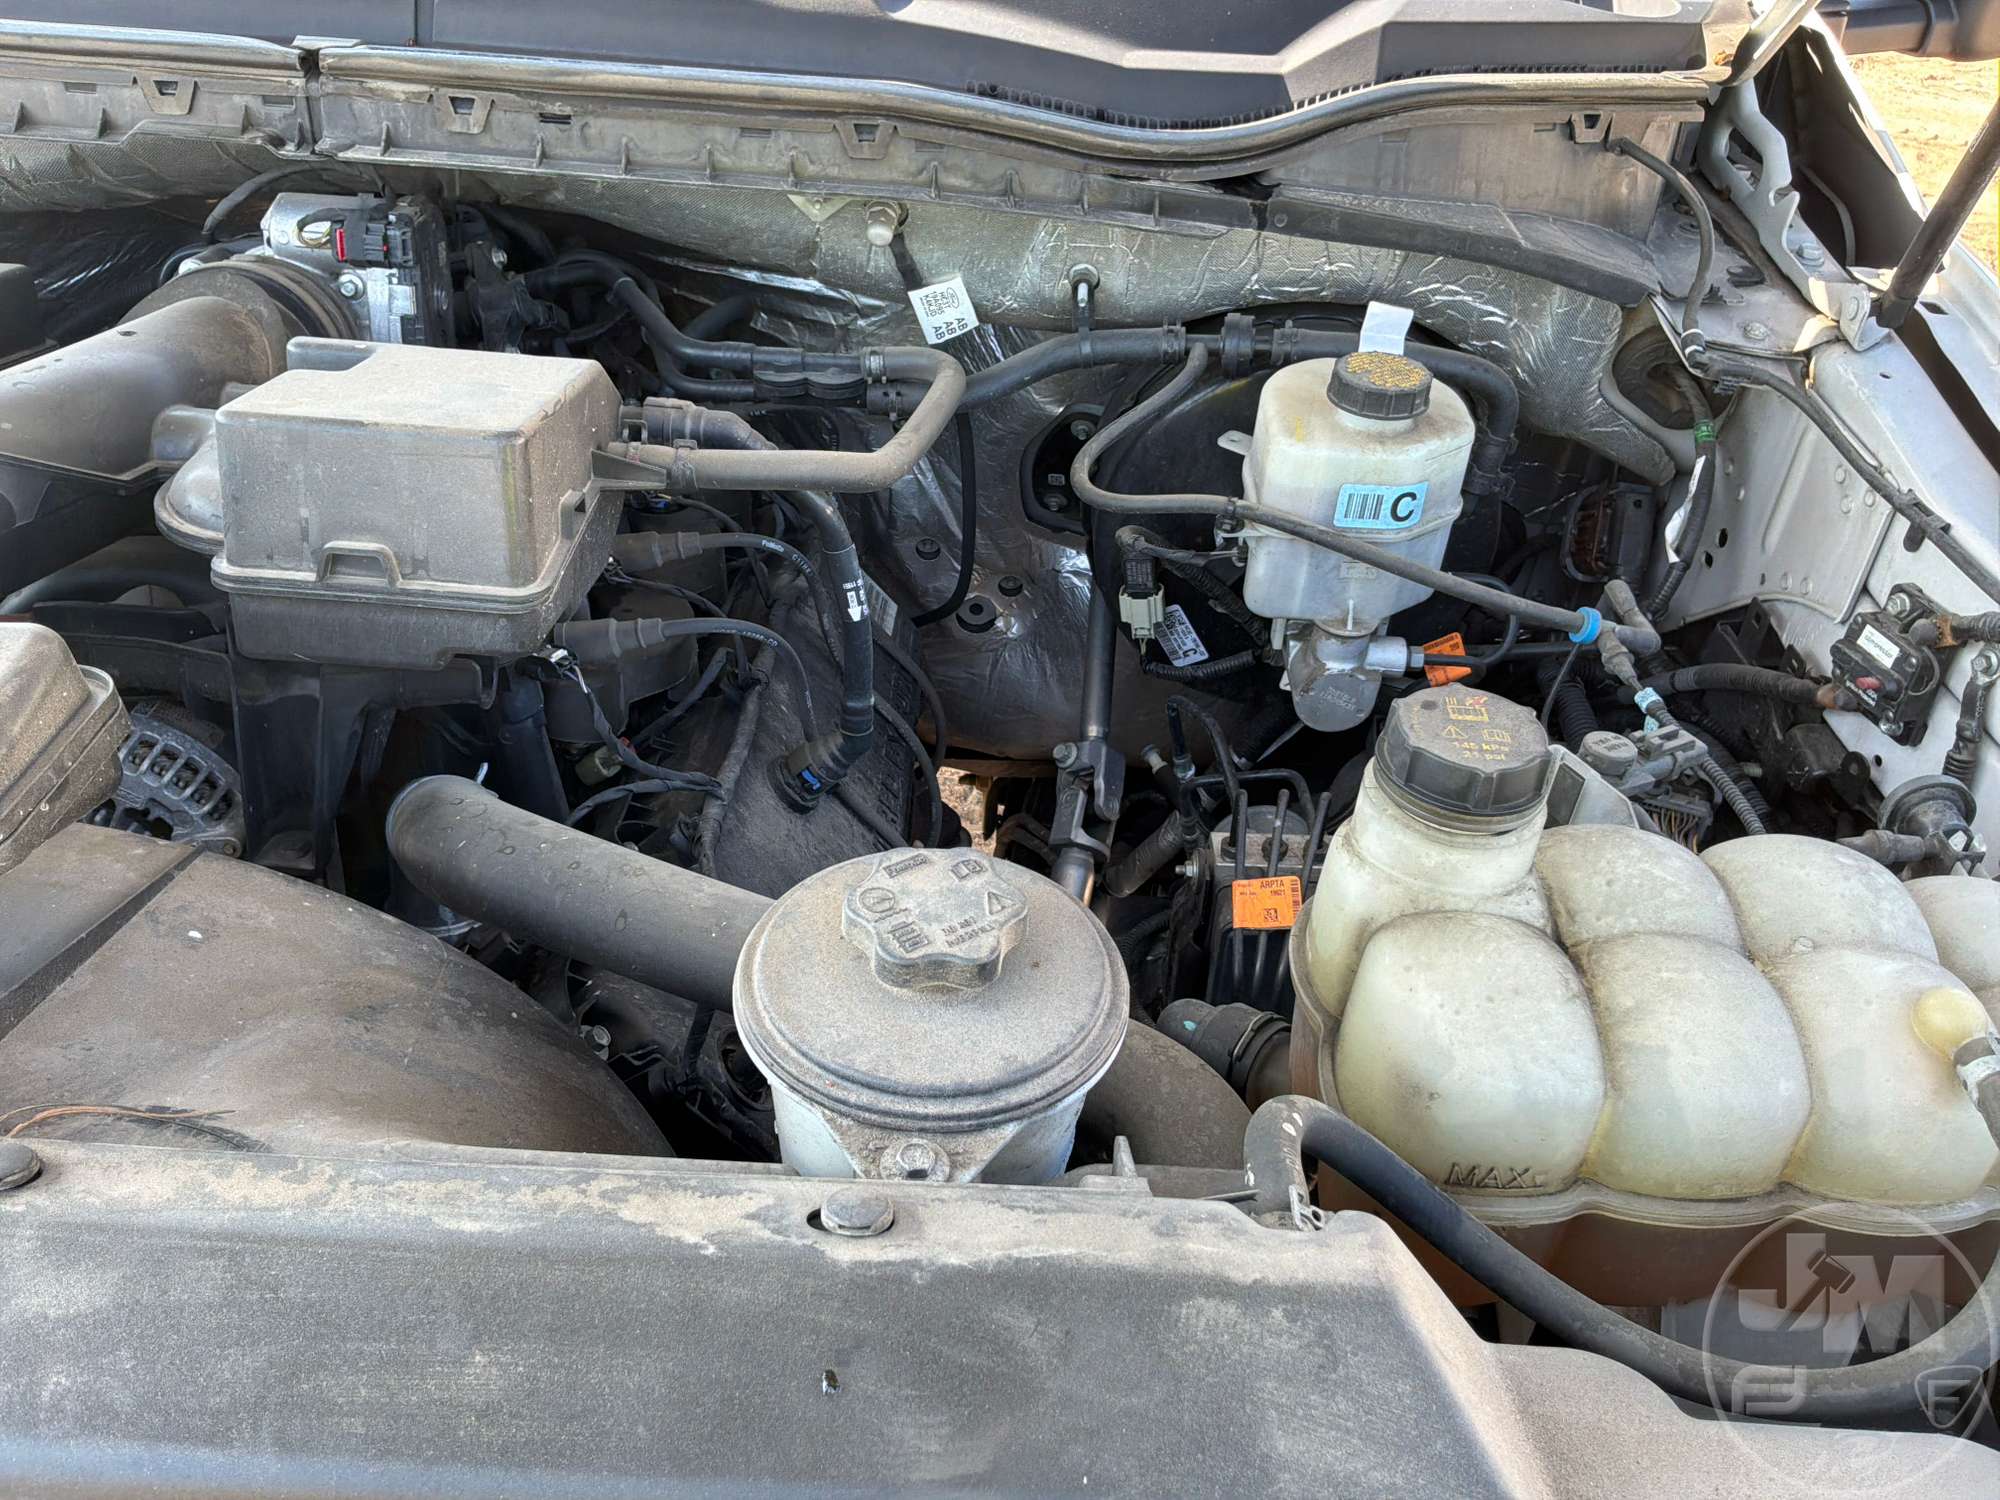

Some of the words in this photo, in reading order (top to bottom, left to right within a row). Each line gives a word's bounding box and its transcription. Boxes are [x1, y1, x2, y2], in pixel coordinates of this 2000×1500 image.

[943, 321, 957, 336] AB
[954, 317, 969, 331] AB
[932, 325, 946, 340] AB
[1390, 491, 1418, 523] C
[1444, 1162, 1531, 1189] MAX
